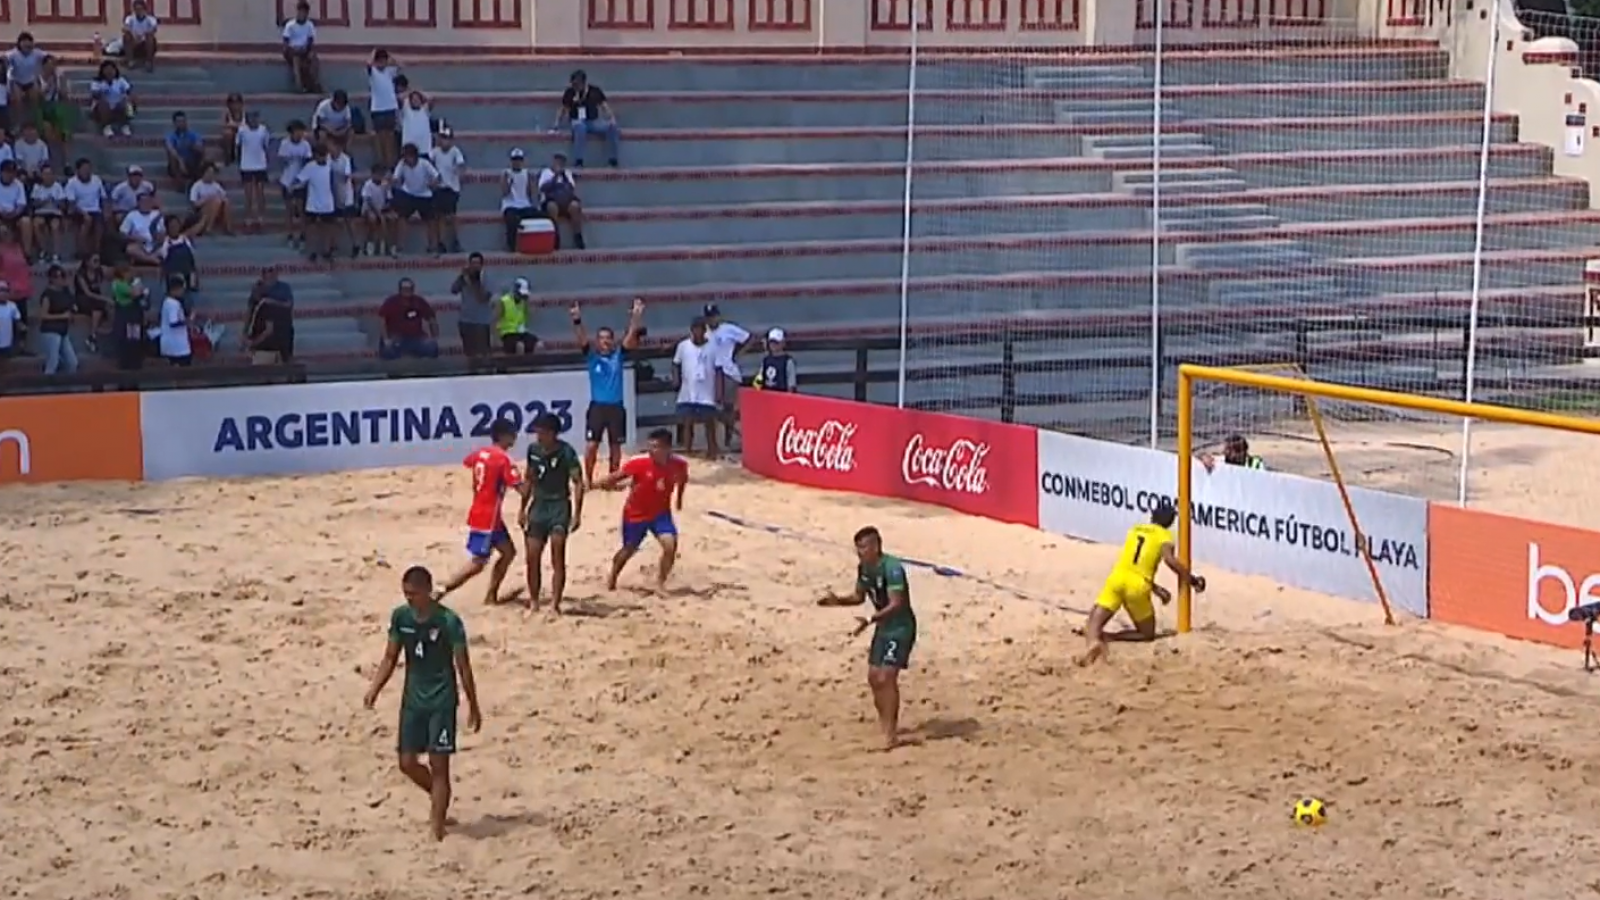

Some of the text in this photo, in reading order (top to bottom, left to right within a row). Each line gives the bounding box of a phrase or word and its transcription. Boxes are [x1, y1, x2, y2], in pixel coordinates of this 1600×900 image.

[214, 400, 573, 452] ARGENTINA 2023
[776, 415, 858, 472] Coca-Cola
[902, 433, 991, 494] Coca-Cola
[1041, 471, 1134, 511] CONMEBOL
[1136, 490, 1180, 513] COP
[1275, 514, 1350, 556] FÚTBOL
[1133, 535, 1145, 565] 1
[414, 640, 424, 659] 4
[887, 641, 897, 657] 2
[438, 728, 449, 745] 4
